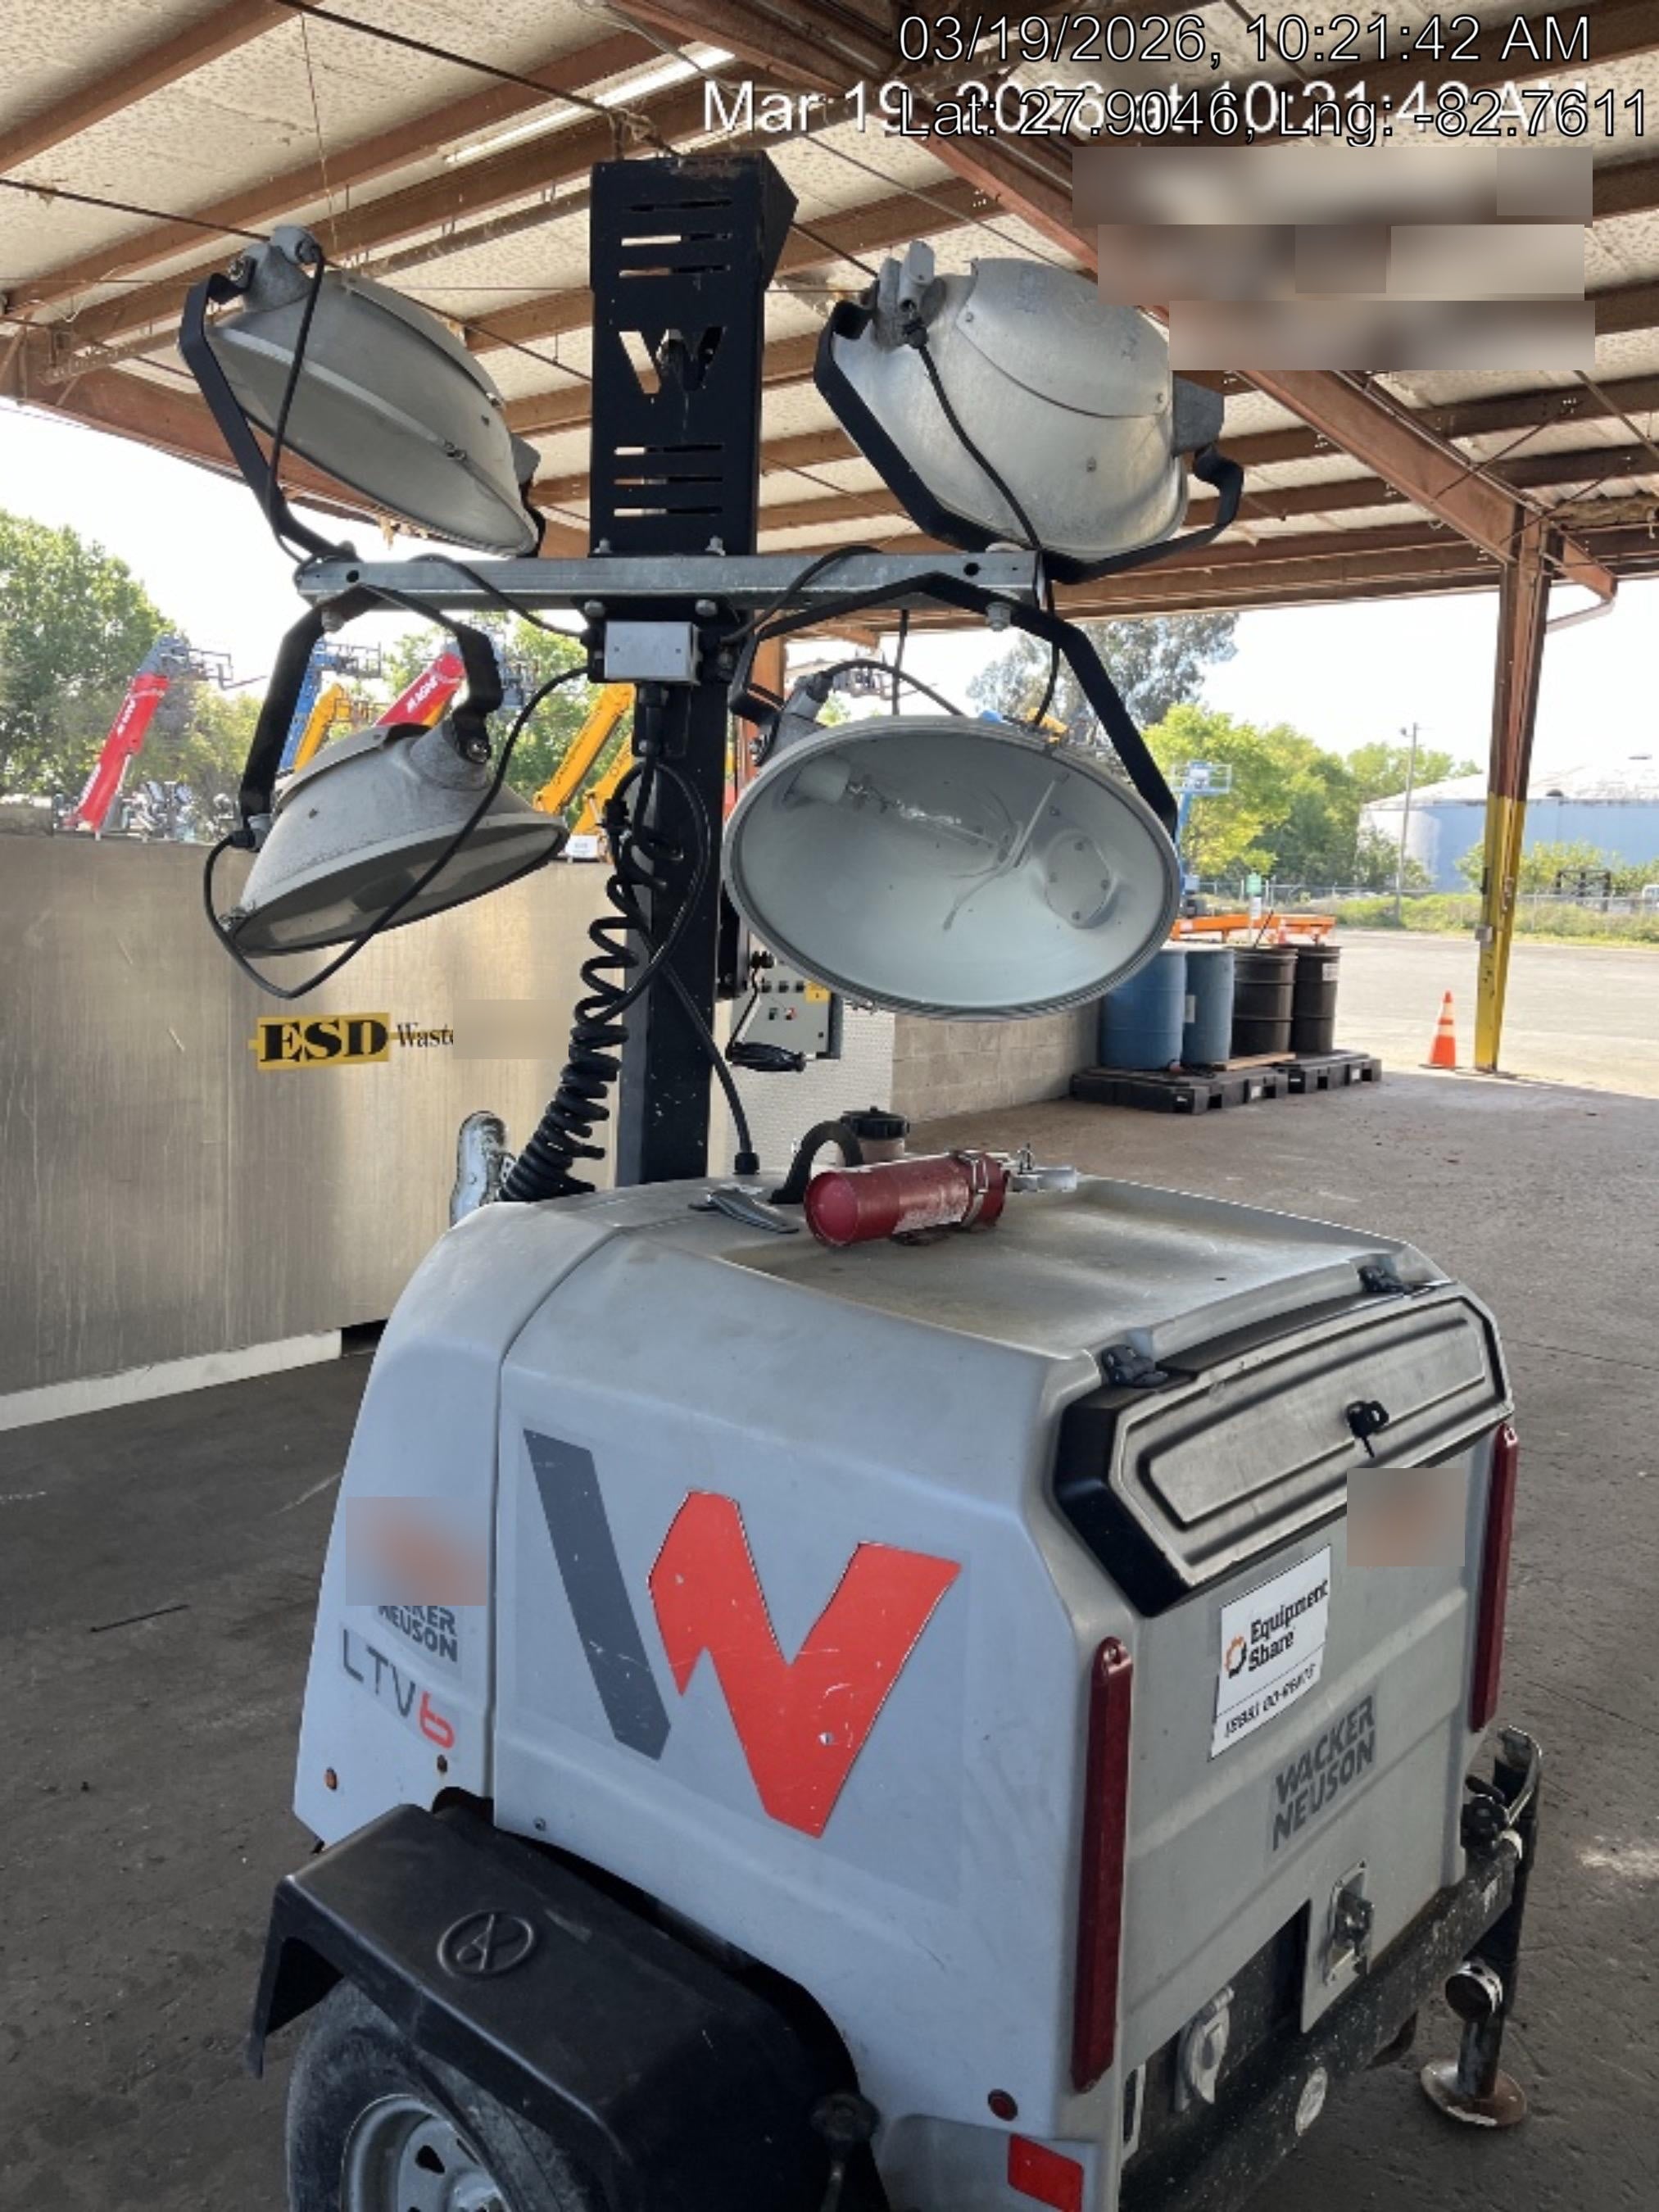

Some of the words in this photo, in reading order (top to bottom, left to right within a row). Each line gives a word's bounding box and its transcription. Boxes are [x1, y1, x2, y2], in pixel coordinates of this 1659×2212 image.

[260, 1019, 388, 1063] ESD
[1248, 1631, 1294, 1672] Share
[1250, 1580, 1328, 1645] Equipment
[343, 1628, 455, 1749] LTV6
[1272, 1730, 1375, 1852] NEUSON
[1276, 1694, 1375, 1805] WACKER
